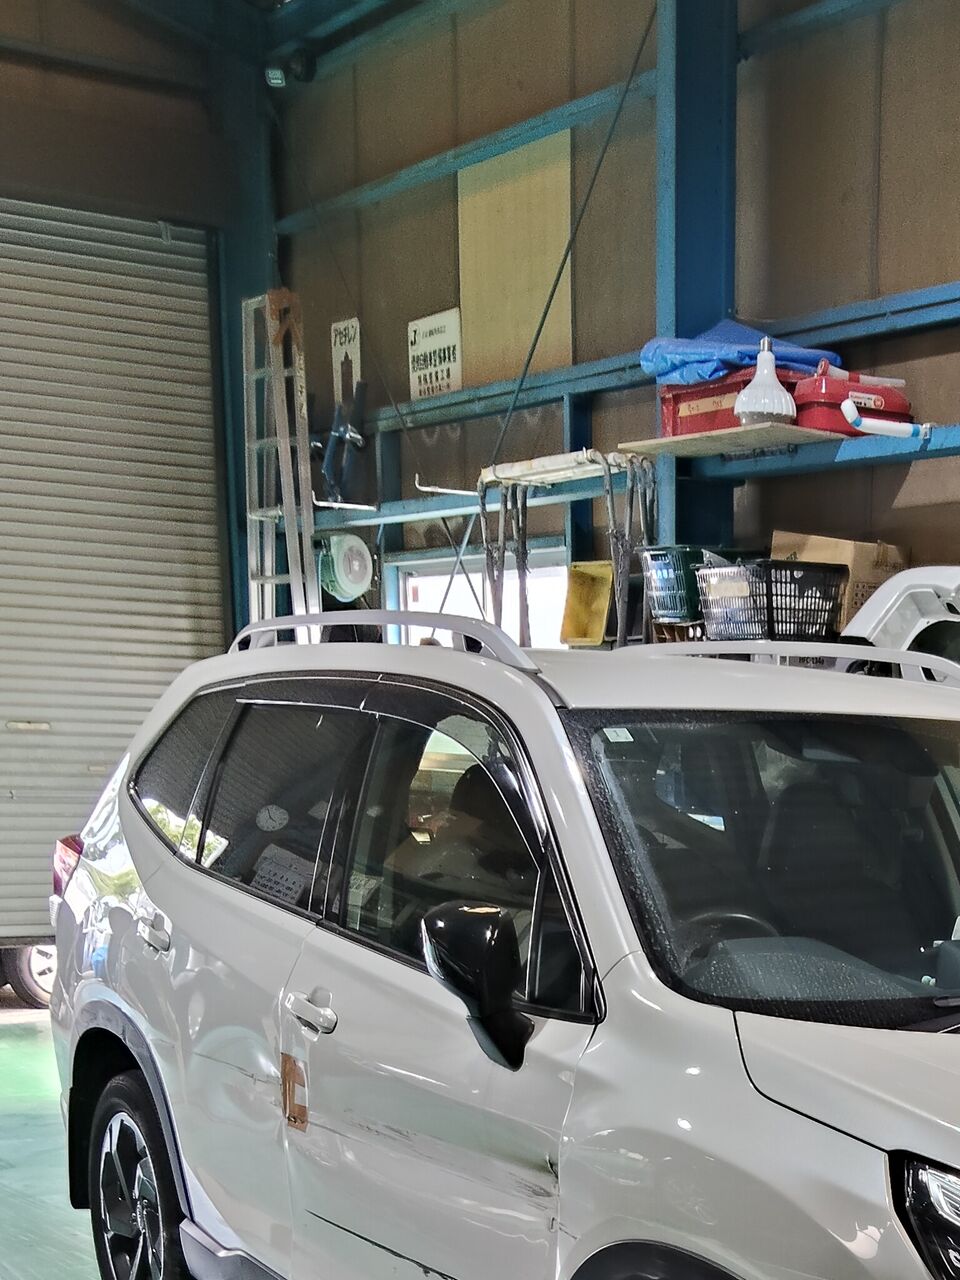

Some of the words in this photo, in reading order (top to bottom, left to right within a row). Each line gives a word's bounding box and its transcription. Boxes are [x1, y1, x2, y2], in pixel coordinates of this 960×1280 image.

[333, 324, 358, 347] アセチレン
